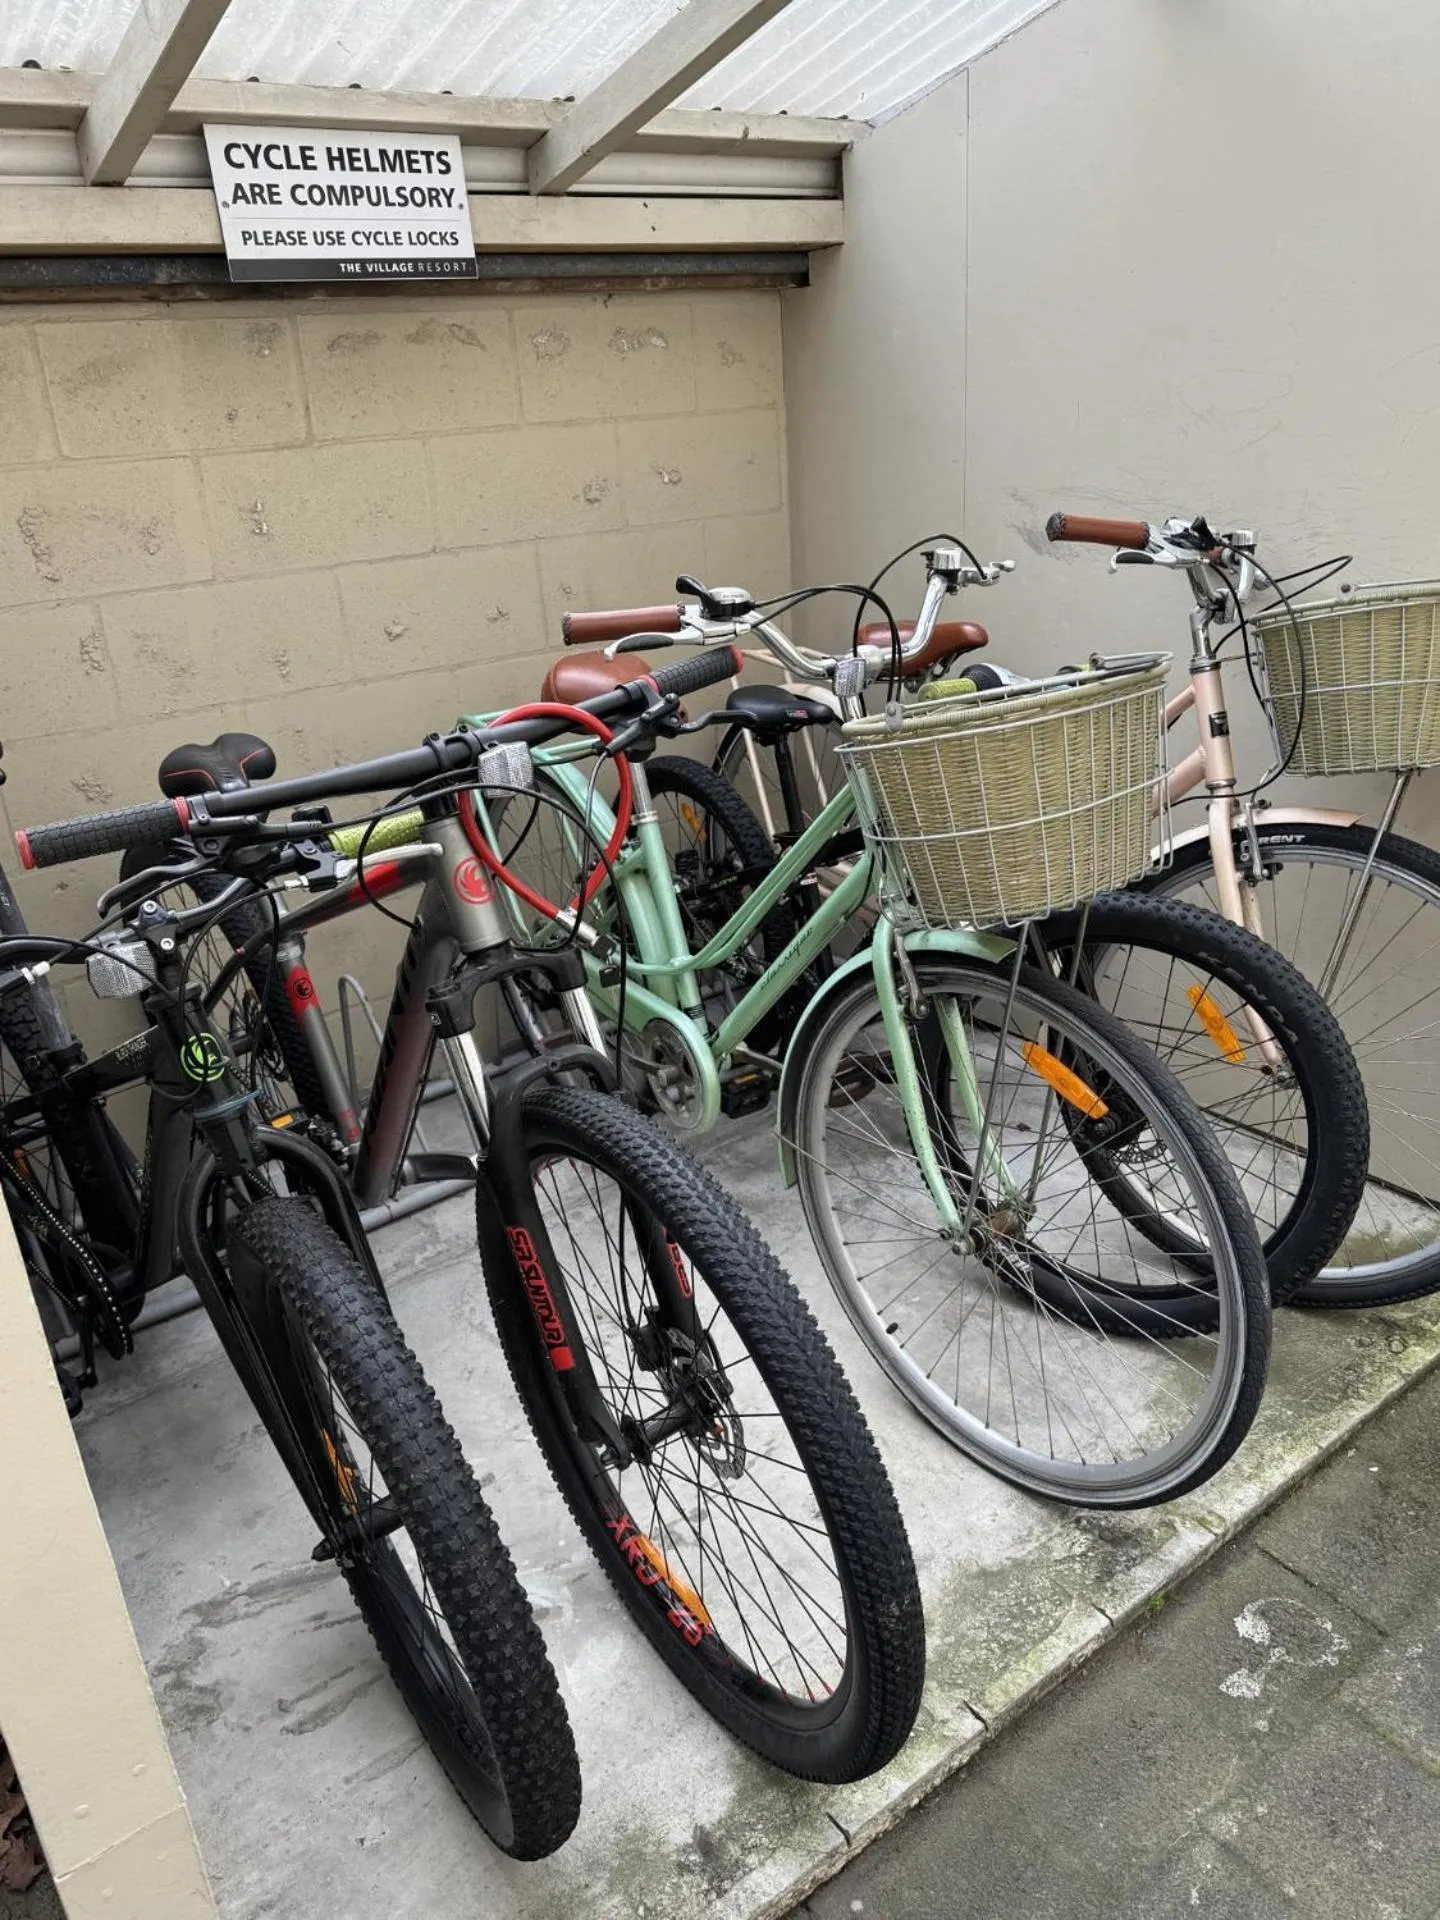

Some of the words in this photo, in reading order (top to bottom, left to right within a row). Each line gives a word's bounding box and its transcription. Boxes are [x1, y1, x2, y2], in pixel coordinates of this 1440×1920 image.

[223, 143, 318, 171] CYCLE
[325, 146, 451, 175] HELMETS
[231, 183, 283, 206] ARE
[290, 184, 455, 208] COMPULSORY
[241, 230, 308, 246] PLEASE
[313, 230, 346, 246] USE
[351, 231, 403, 246] CYCLE
[408, 231, 459, 246] LOCKS
[339, 262, 361, 273] THE
[365, 262, 414, 273] VILLAGE
[418, 262, 467, 272] RESORT
[522, 1260, 564, 1344] SUNTOUR
